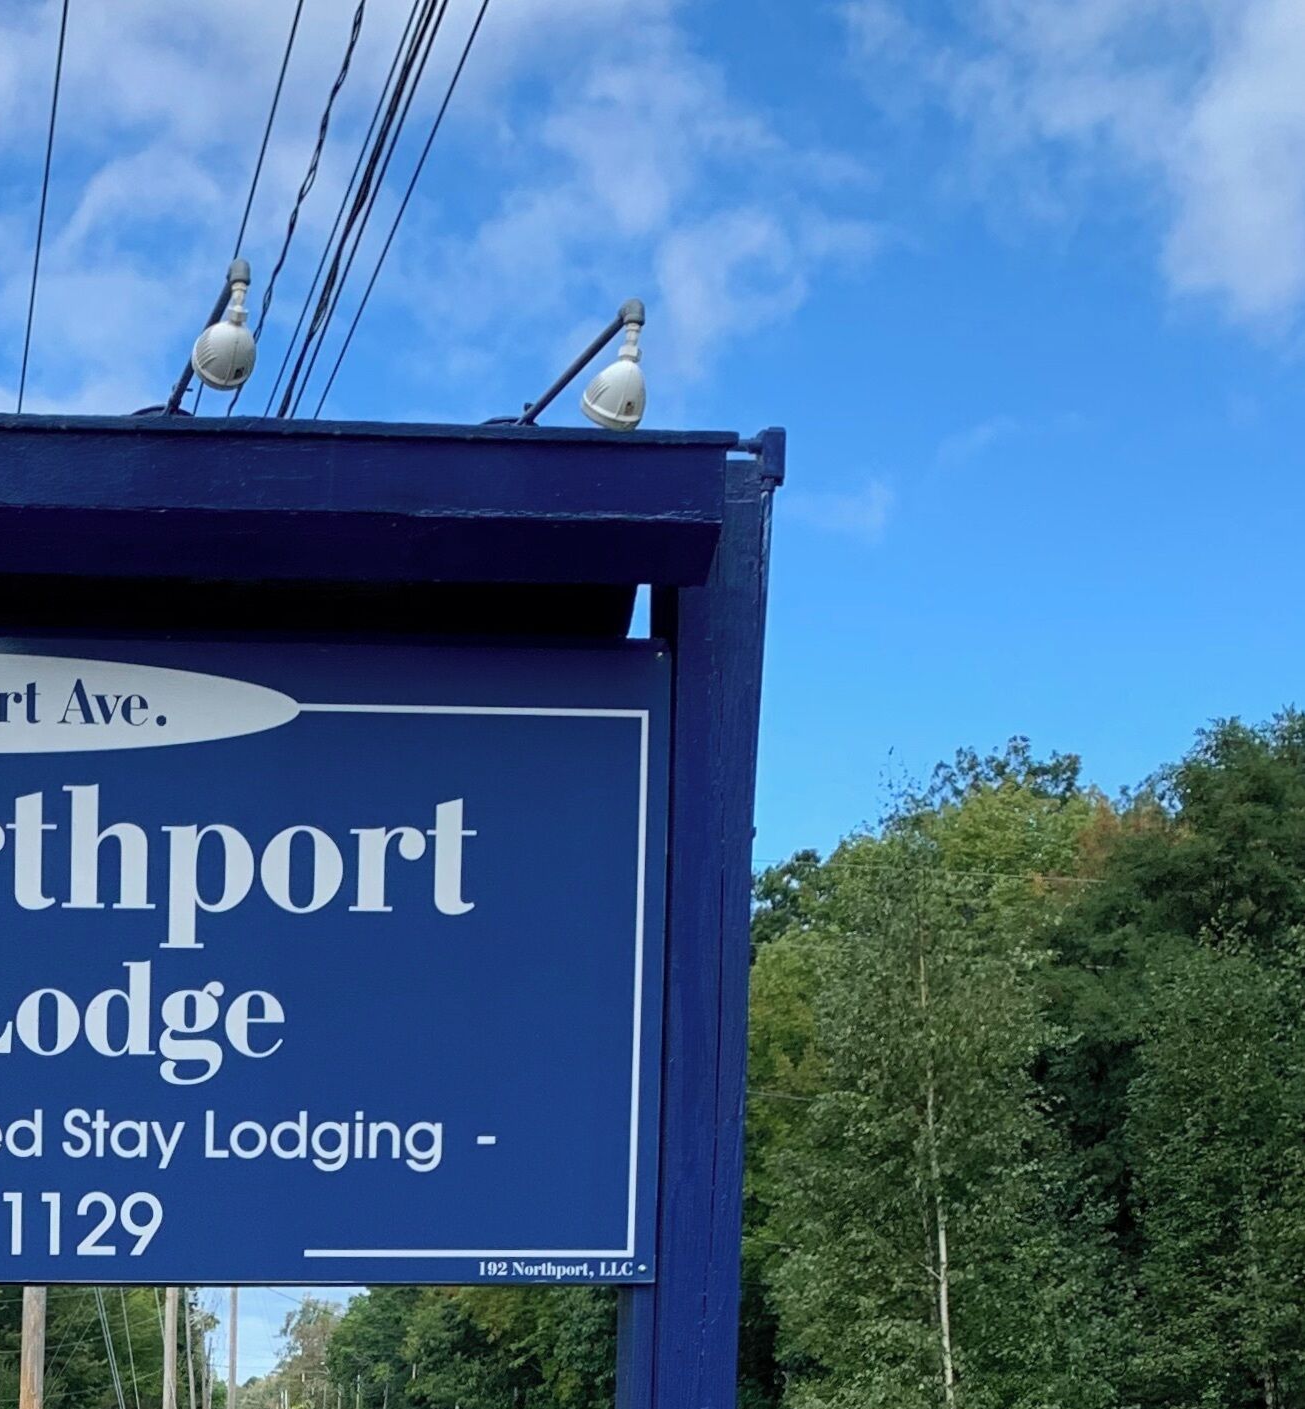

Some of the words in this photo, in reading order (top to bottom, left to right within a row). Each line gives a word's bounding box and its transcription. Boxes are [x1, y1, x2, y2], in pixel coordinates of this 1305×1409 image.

[56, 677, 167, 727] Ave.
[62, 1108, 185, 1169] Stay
[205, 1110, 442, 1172] Lodging
[479, 1261, 508, 1276] 192
[512, 1261, 595, 1280] Northport,
[599, 1261, 633, 1276] LLC
